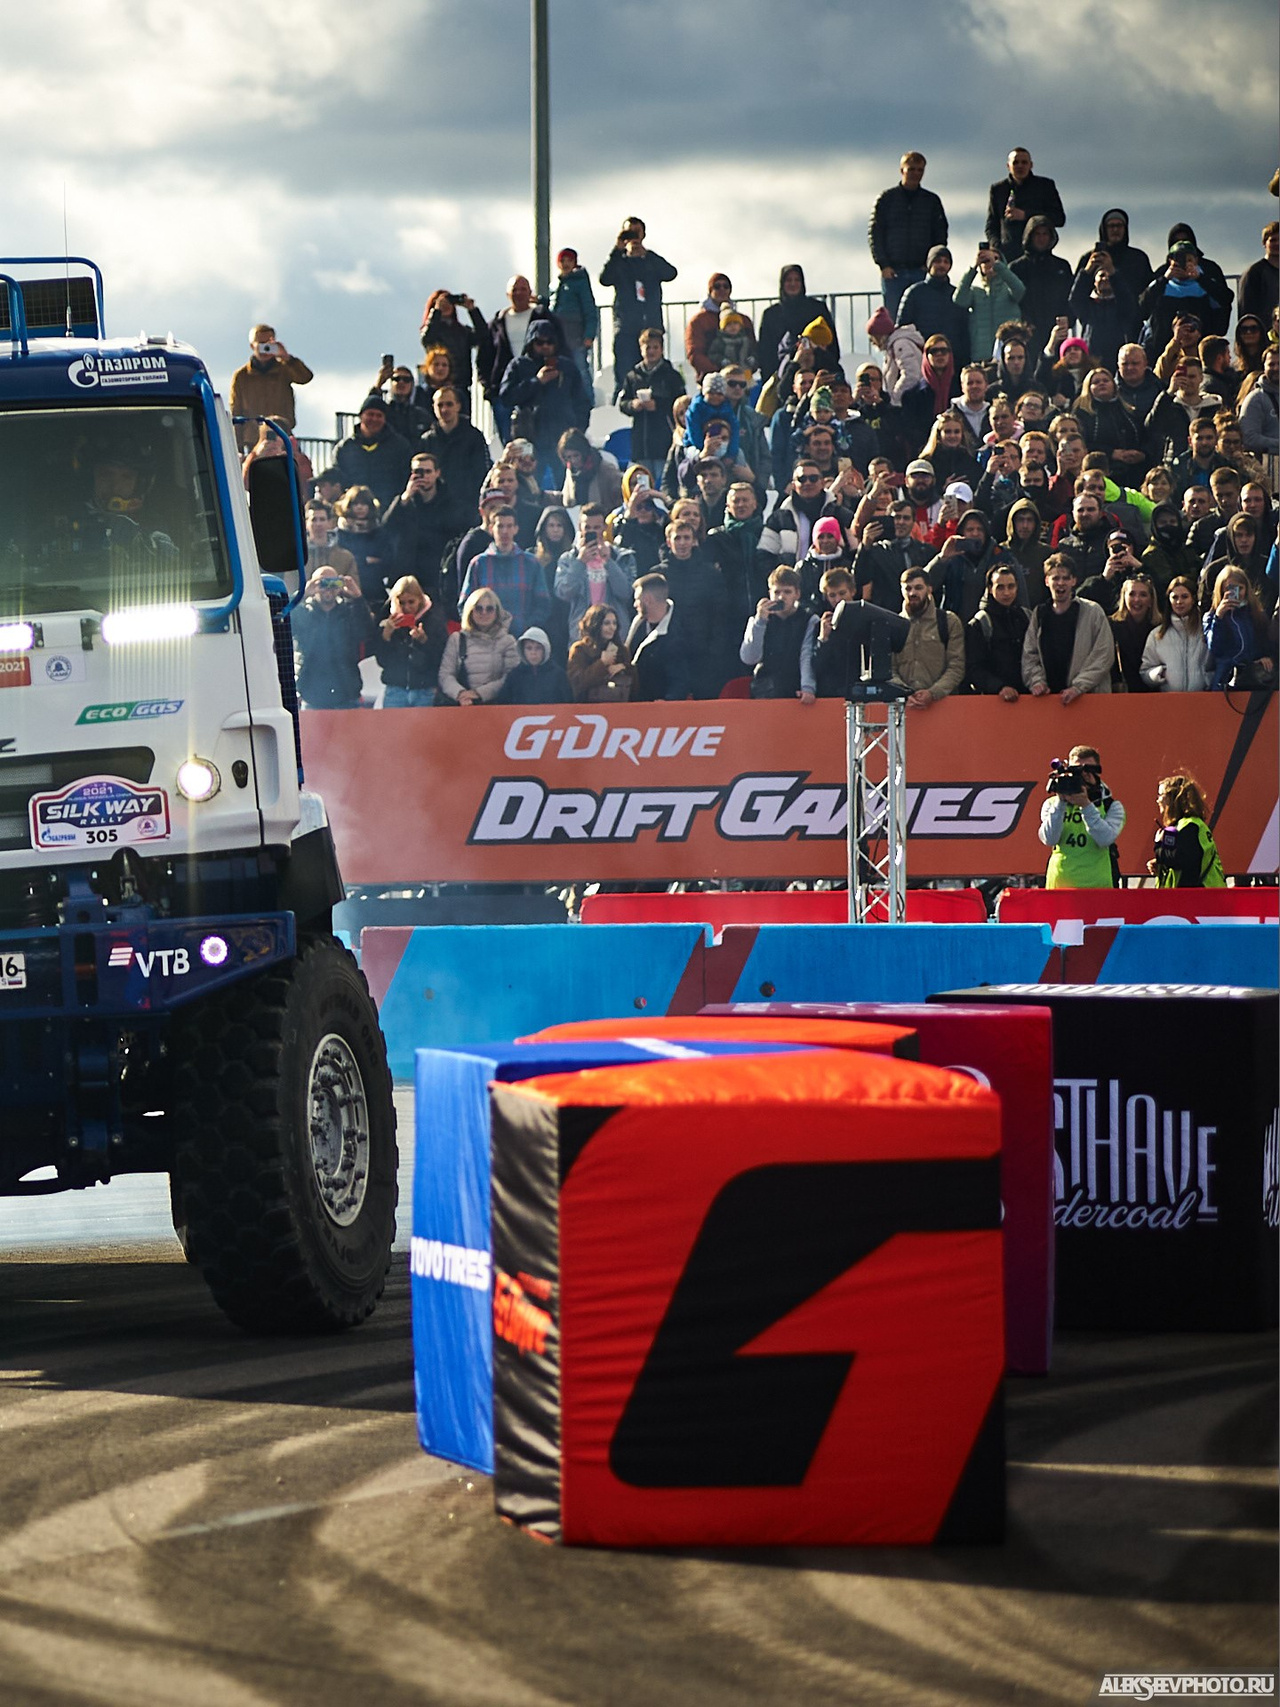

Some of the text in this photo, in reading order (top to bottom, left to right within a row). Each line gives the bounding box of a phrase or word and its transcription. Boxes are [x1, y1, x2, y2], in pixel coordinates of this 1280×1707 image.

[97, 357, 166, 372] ГАЗПРОМ
[82, 786, 113, 796] 2021
[46, 797, 155, 820] SILK WAY
[470, 780, 721, 843] DRIFT
[80, 816, 123, 825] RALLY
[86, 829, 118, 844] 305
[1066, 833, 1087, 848] 40
[135, 948, 190, 978] VTB
[1054, 1189, 1197, 1229] dercoal
